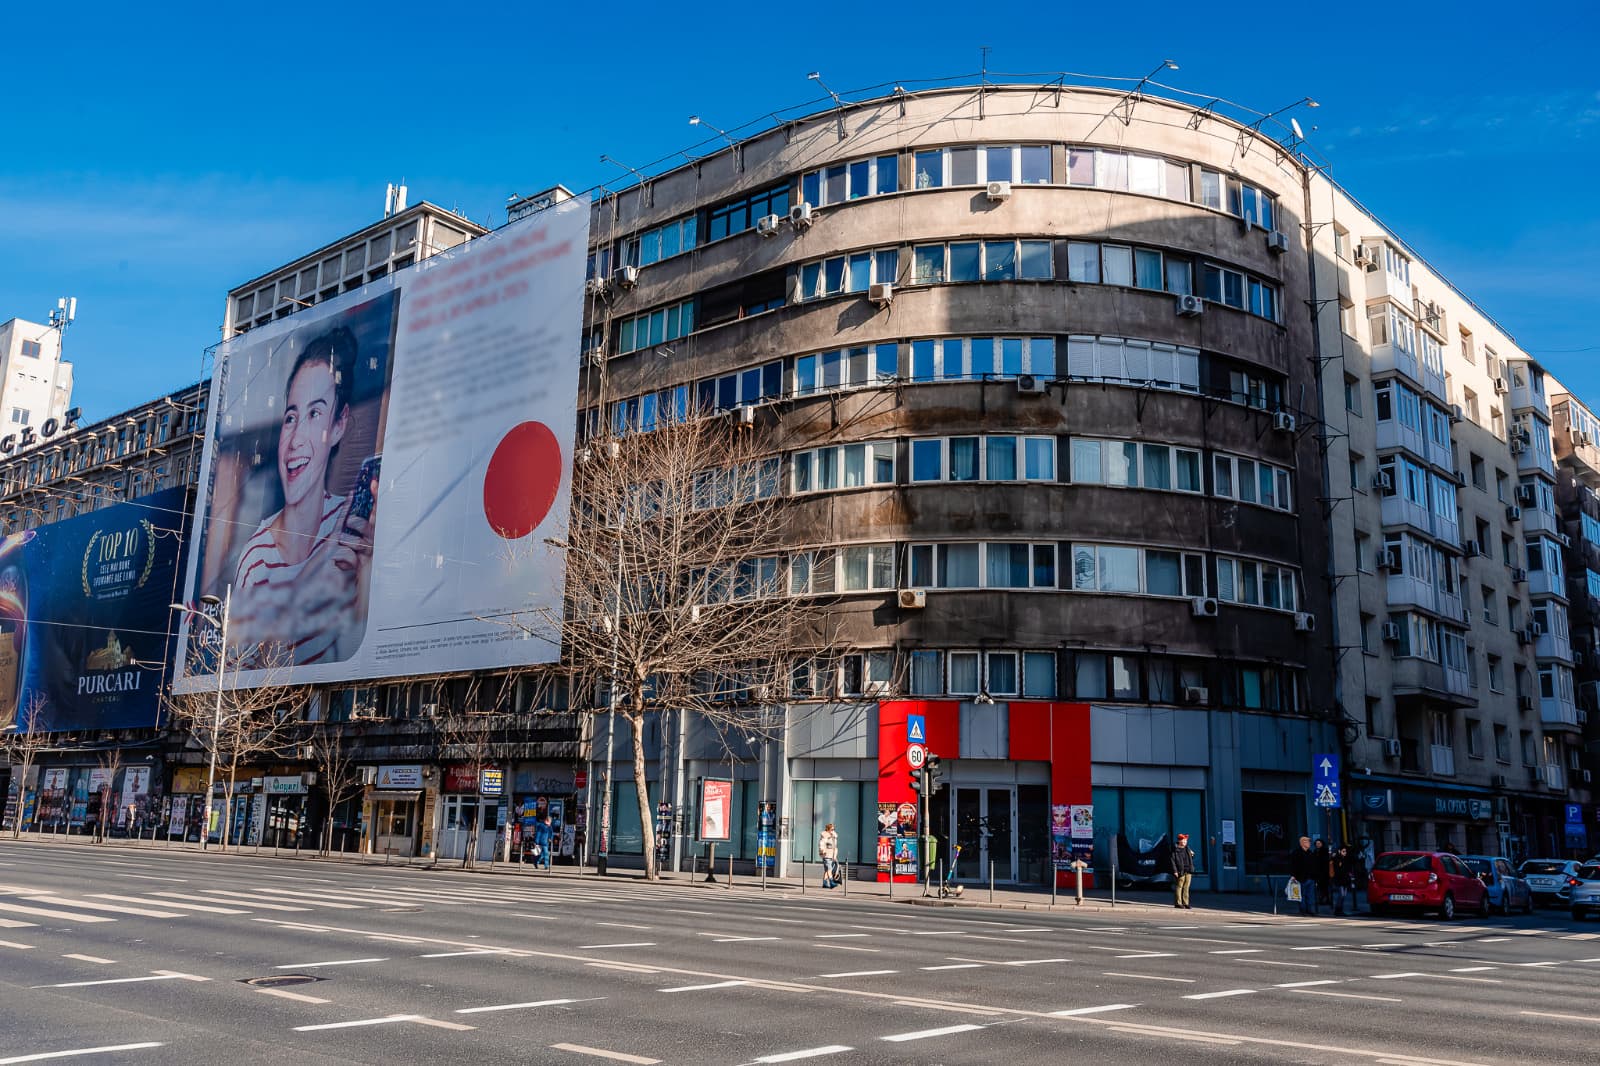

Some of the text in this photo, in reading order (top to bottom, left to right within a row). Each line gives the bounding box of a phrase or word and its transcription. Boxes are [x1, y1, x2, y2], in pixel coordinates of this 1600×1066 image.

[99, 528, 138, 562] TOP 10
[78, 671, 141, 695] PURCARI
[911, 750, 922, 763] 60
[1569, 806, 1578, 817] P
